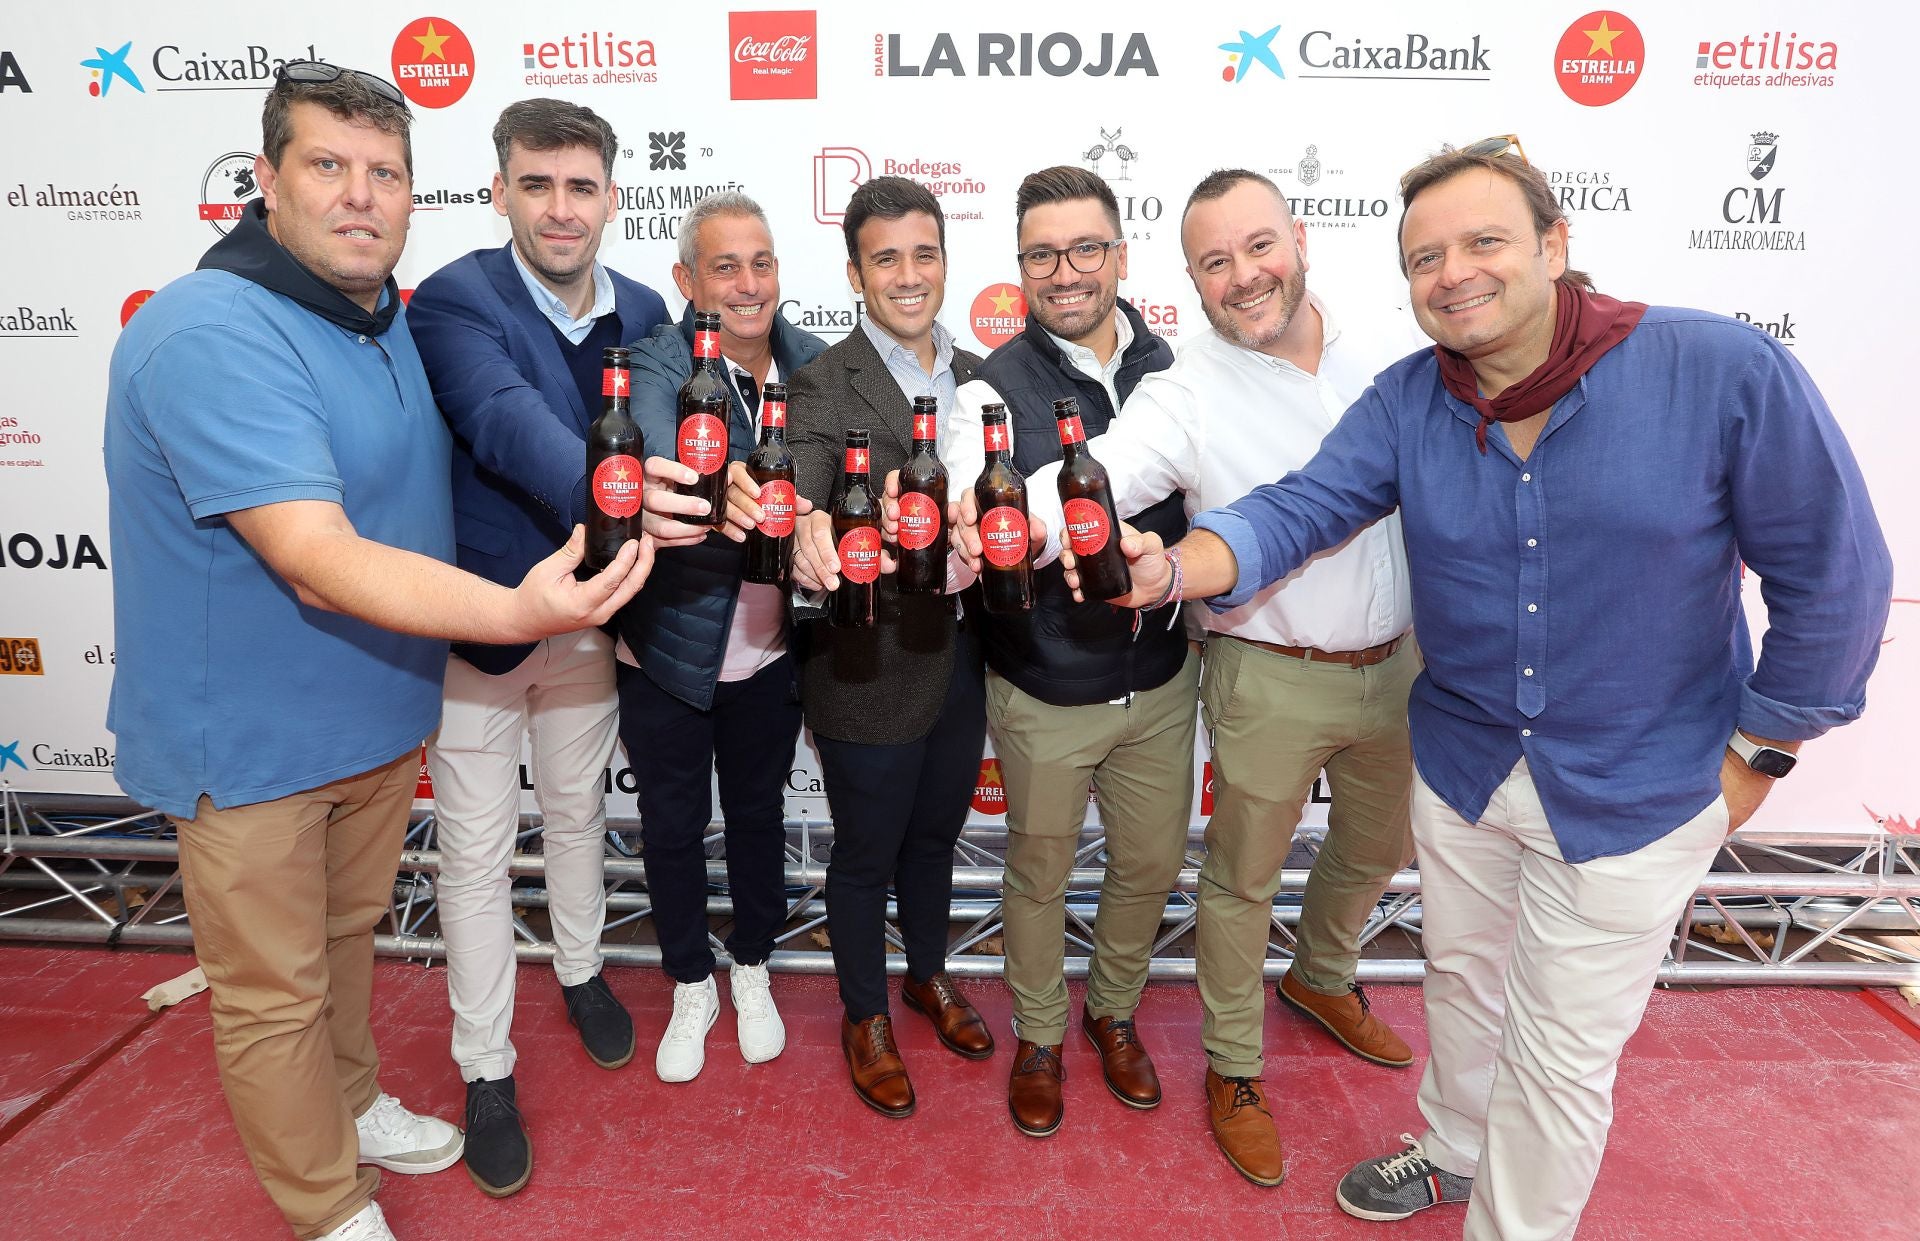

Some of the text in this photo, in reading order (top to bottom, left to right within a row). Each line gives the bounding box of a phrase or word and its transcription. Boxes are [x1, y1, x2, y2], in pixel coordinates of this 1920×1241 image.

[538, 31, 657, 69] etilisa
[734, 35, 811, 63] Coca-Cola
[874, 33, 884, 77] DIARIO
[888, 32, 1159, 77] LA RIOJA
[1299, 30, 1491, 71] CaixaBank
[1712, 31, 1838, 70] etilisa
[399, 63, 469, 79] ESTRELLA
[752, 67, 769, 75] Real
[1561, 59, 1636, 75] ESTRELLA
[419, 78, 450, 88] DAMM
[525, 70, 657, 88] etiquetas adhesivas
[1581, 75, 1614, 84] DAMM
[1693, 72, 1834, 89] etiquetas adhesivas
[622, 147, 713, 159] 19 70
[884, 158, 961, 178] Bodegas
[7, 183, 141, 207] el almacén
[1722, 186, 1786, 224] CM
[67, 210, 142, 221] GASTROBAR
[950, 211, 984, 221] capital.
[625, 217, 645, 240] DE
[1688, 229, 1806, 251] MATARROMERA
[975, 317, 1026, 328] ESTRELL
[991, 327, 1015, 335] DAMM
[685, 438, 720, 448] ESTRELLA
[602, 481, 639, 490] ESTRELLA
[1068, 520, 1100, 531] ESTRELLA
[987, 530, 1022, 540] ESTRELLA
[84, 644, 104, 665] el
